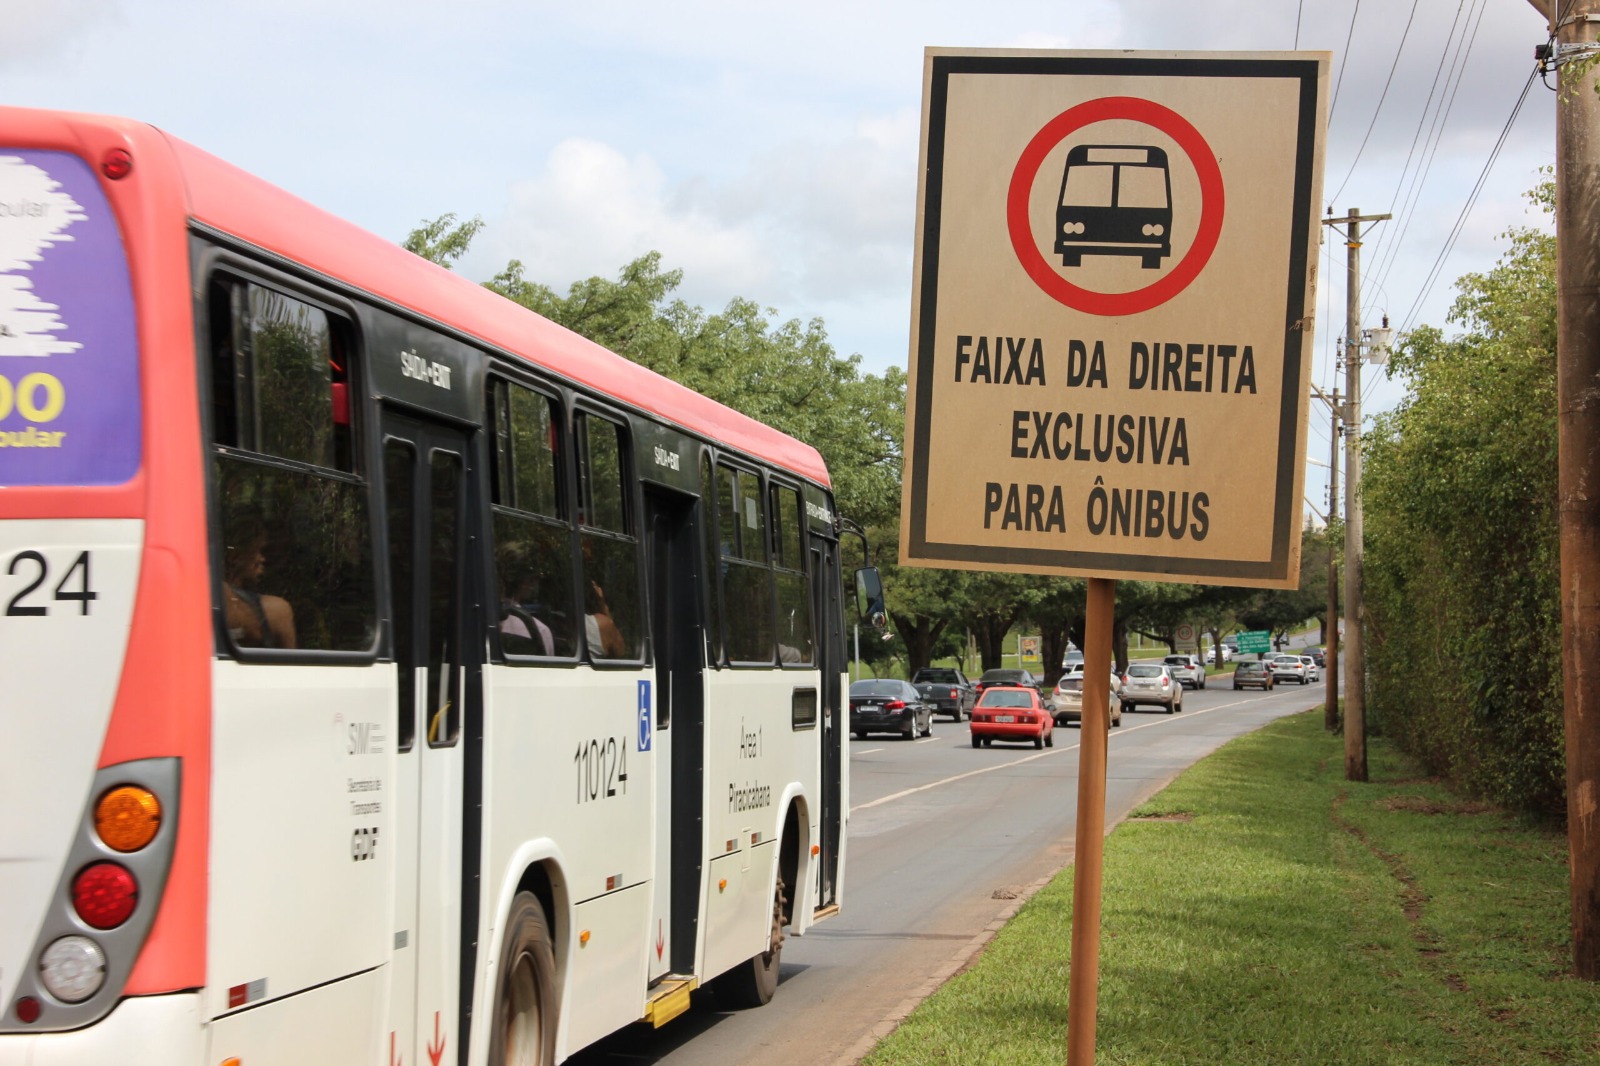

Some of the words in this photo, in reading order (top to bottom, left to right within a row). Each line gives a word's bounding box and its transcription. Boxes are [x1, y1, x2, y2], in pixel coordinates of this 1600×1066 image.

[955, 336, 1046, 386] FAIXA
[1067, 340, 1108, 388] DA
[1129, 342, 1257, 394] DIREITA
[1011, 411, 1189, 465] EXCLUSIVA
[984, 482, 1066, 533] PARA
[1087, 476, 1209, 541] ÔNIBUS
[5, 549, 98, 617] 24
[740, 716, 757, 759] Área
[574, 736, 628, 805] 110124
[729, 780, 771, 814] Piracicabana
